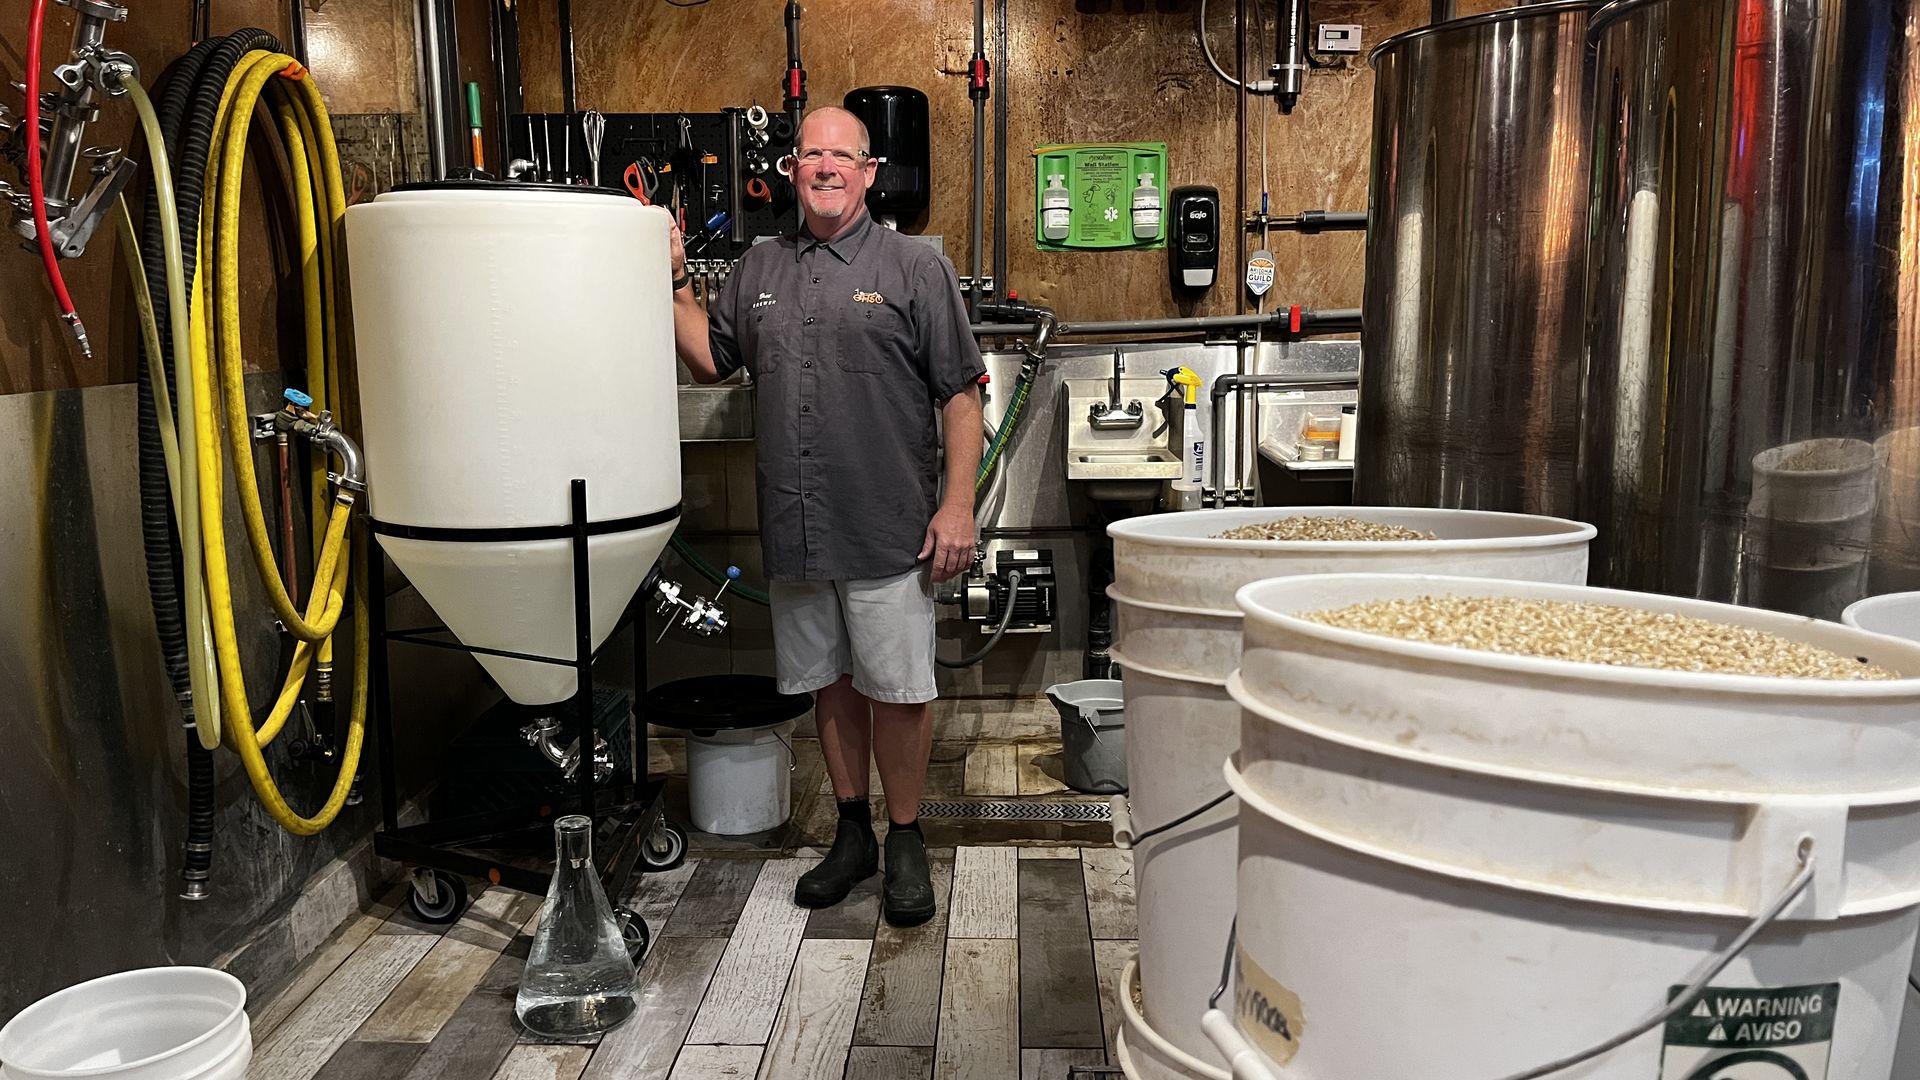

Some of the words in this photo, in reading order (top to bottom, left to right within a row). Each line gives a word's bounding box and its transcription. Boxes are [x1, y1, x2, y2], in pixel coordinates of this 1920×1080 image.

[1248, 274, 1272, 282] GUILD
[1716, 994, 1823, 1018] WARNING
[1735, 1020, 1802, 1041] AVISO
